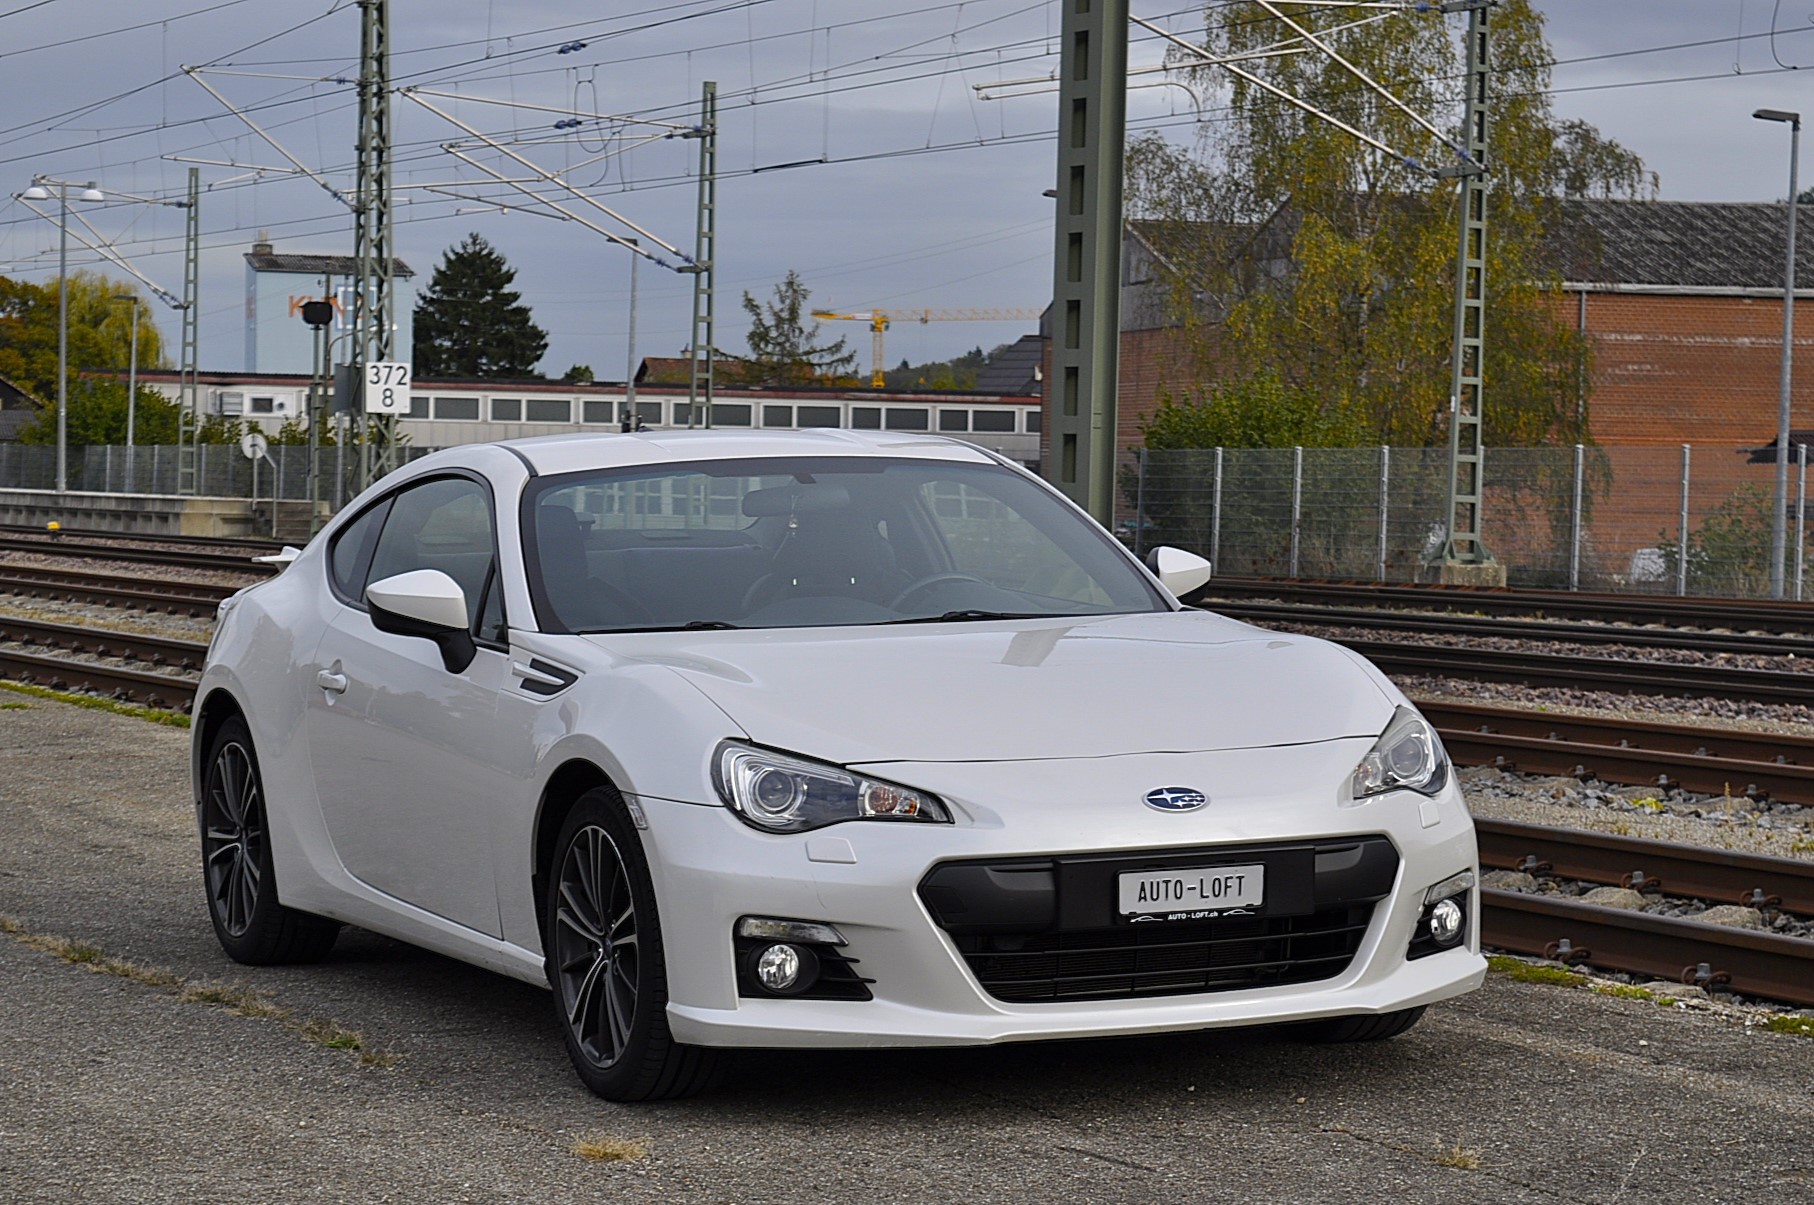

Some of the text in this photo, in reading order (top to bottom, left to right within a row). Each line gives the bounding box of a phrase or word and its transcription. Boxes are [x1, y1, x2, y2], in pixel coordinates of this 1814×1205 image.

[369, 365, 407, 385] 372
[382, 387, 394, 407] 8
[1138, 875, 1245, 902] AUTO-LOFT
